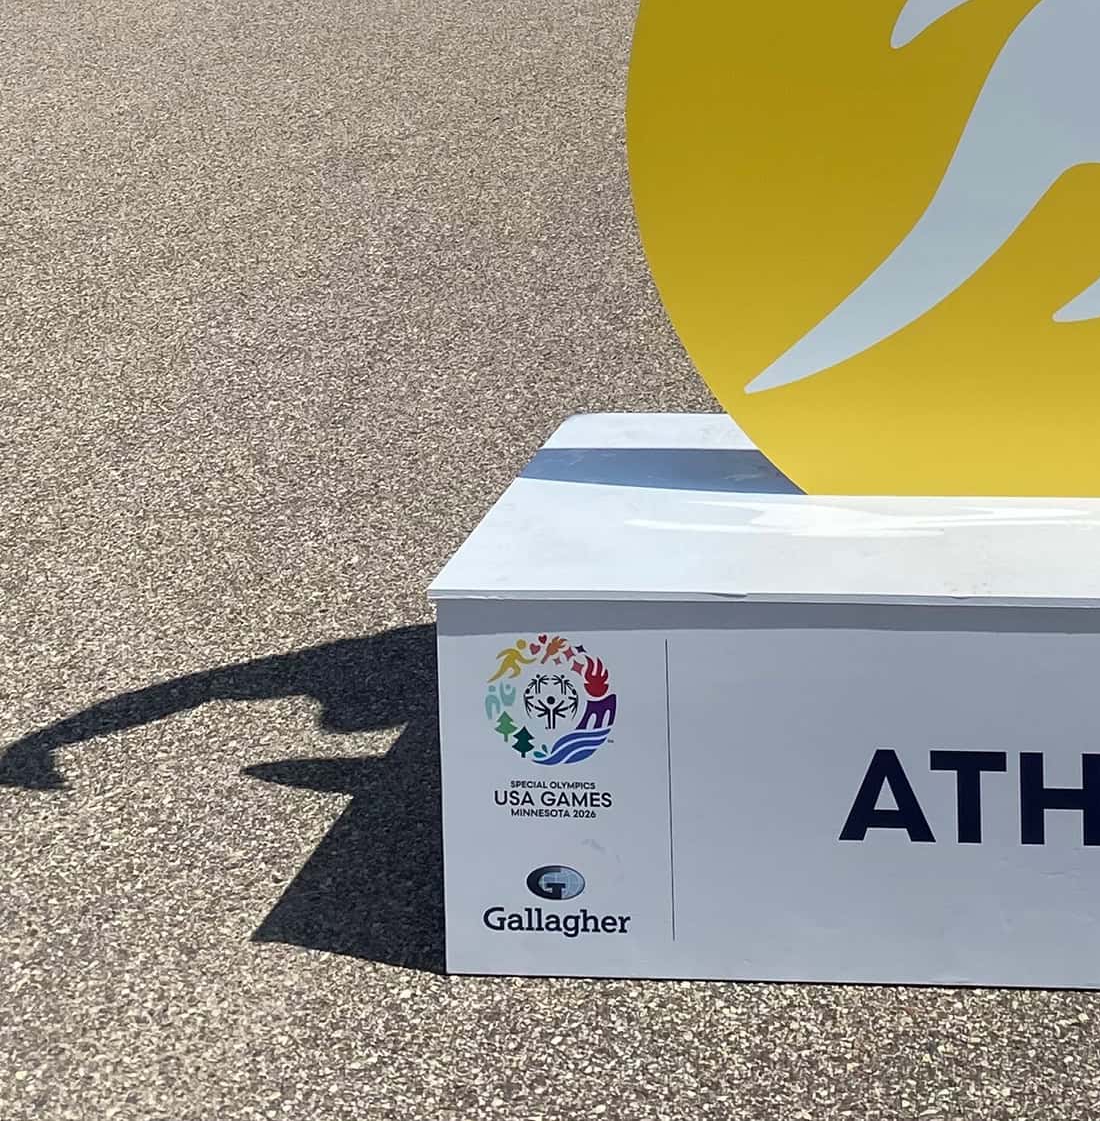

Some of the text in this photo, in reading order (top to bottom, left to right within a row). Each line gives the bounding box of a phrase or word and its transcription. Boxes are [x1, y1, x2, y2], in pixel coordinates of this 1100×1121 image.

[510, 780, 596, 790] SPECIAL OLYMPICS
[494, 790, 612, 808] USA GAMES
[510, 808, 597, 819] MINNESOTA 2026
[483, 907, 631, 937] Gallagher
